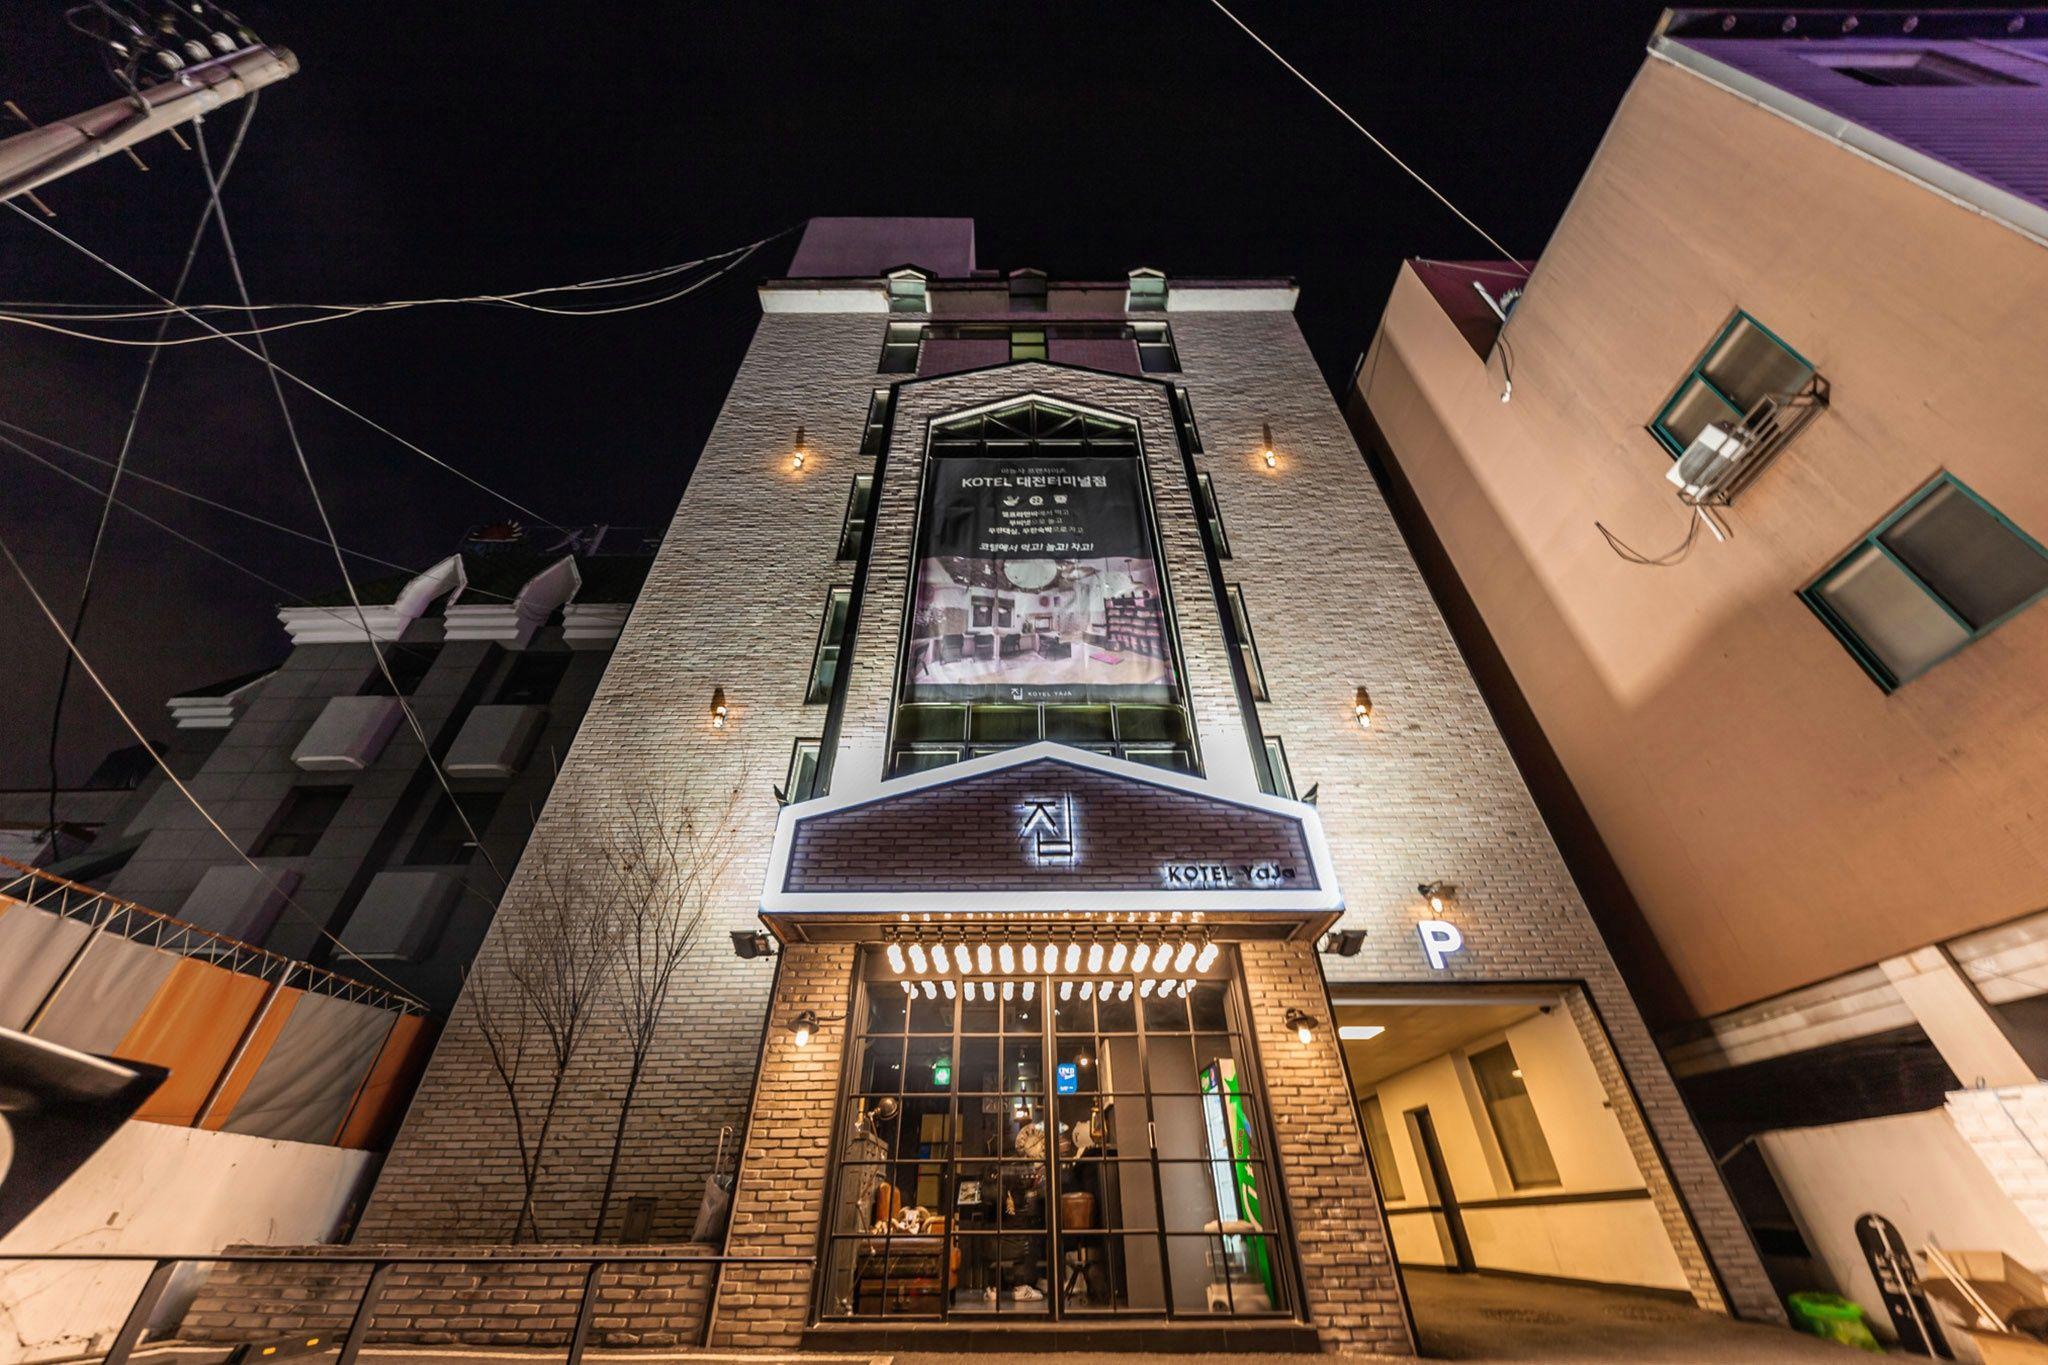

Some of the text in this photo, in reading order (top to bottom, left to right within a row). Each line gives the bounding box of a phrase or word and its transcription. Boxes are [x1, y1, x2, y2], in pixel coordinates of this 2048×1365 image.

[961, 475, 1108, 488] KOTEL 대전터미널점
[1021, 795, 1074, 858] 집
[1168, 865, 1234, 883] KOTEL
[1416, 919, 1463, 970] P
